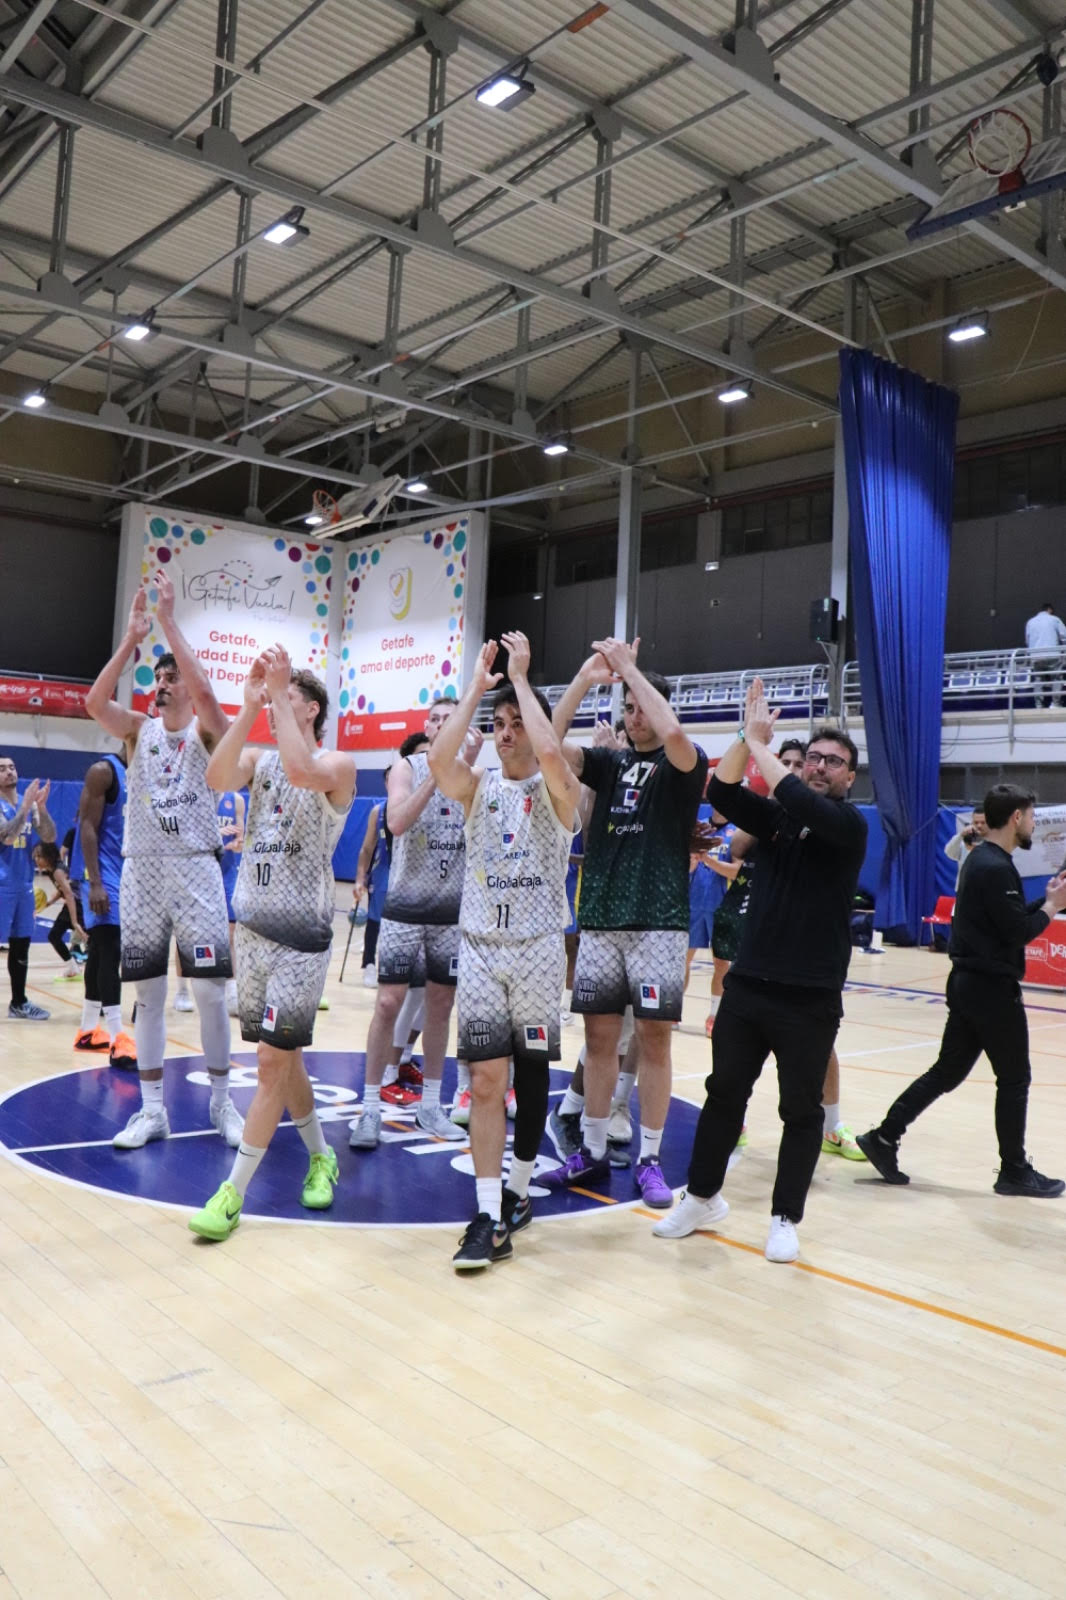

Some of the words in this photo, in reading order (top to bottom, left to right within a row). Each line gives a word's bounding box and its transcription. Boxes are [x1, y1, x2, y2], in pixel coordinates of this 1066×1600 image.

[209, 630, 260, 649] Getafe,
[381, 634, 415, 651] Getafe
[360, 661, 383, 674] ama
[384, 659, 394, 671] el
[395, 654, 436, 673] deporte
[621, 761, 656, 787] 47
[159, 816, 180, 835] 44
[256, 862, 271, 886] 10
[439, 859, 449, 879] 5
[486, 874, 542, 890] Globalcaja
[496, 904, 510, 929] 11
[642, 986, 657, 1001] BA
[526, 1026, 547, 1041] BA
